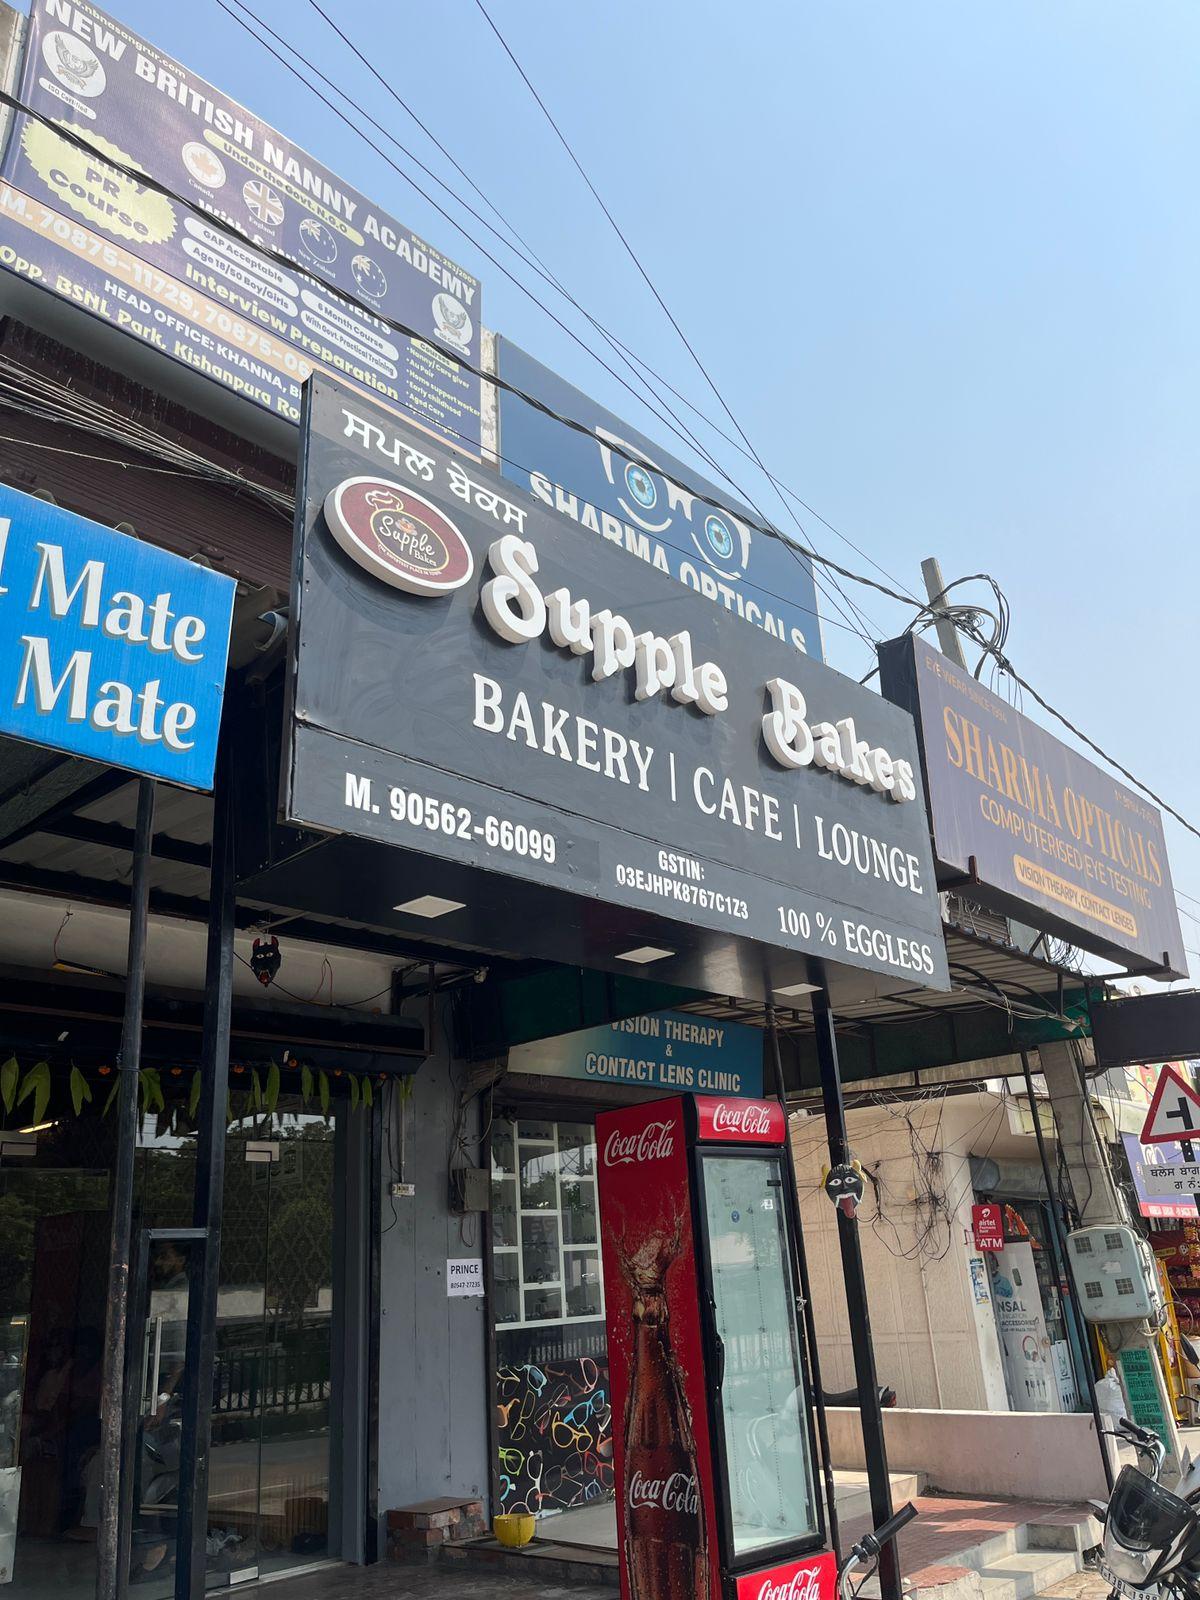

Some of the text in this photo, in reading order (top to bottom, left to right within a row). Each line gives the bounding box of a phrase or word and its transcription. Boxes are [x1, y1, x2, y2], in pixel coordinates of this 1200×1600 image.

[45, 0, 127, 61] NEW
[134, 53, 254, 150] BRITISH
[263, 139, 357, 222] NANNY
[363, 214, 475, 306] ACADEMY
[224, 142, 262, 173] Under
[263, 169, 281, 187] the
[3, 190, 33, 221] M.
[49, 168, 149, 236] Course
[85, 167, 120, 200] PR
[193, 246, 213, 265] Age
[203, 230, 225, 247] GAP
[226, 244, 284, 283] Acceptable
[0, 245, 48, 283] Opp.
[55, 275, 111, 318] BSNL
[174, 341, 271, 406] Kishanpura
[104, 279, 151, 314] HEAD
[153, 308, 215, 351] OFFICE:
[216, 343, 286, 394] KHANNA,
[186, 263, 287, 334] Interview
[290, 326, 399, 400] Preparation
[305, 313, 322, 328] With
[324, 305, 353, 328] Month
[354, 326, 384, 350] Course
[379, 515, 435, 556] Supple
[529, 471, 670, 575] SHARMA
[414, 550, 438, 567] Bakes
[31, 542, 206, 660] Mate
[480, 534, 916, 804] Supple Bakes
[17, 635, 197, 750] Mate
[471, 673, 923, 895] BAKERY CAFE LOUNGE
[943, 706, 1163, 888] SHARMA OPTICALS
[344, 772, 556, 864] M. 90562-66099
[657, 850, 705, 880] GSTIN:
[980, 795, 1083, 871] COMPUTERISED
[1083, 854, 1107, 886] EYE
[1106, 866, 1151, 909] TESTING
[1019, 861, 1045, 883] VISION
[777, 906, 934, 975] 100 % EGGLESS
[664, 1020, 724, 1048] THERAPY
[665, 1043, 673, 1058] &
[585, 1052, 741, 1093] CONTACT LENS CLINIC
[713, 1103, 771, 1134] Coca-Cola
[604, 1120, 677, 1167] Coca-Cola
[980, 1238, 1003, 1248] ATM
[450, 1264, 479, 1275] PRINCE
[629, 1470, 700, 1514] Coca-Cola
